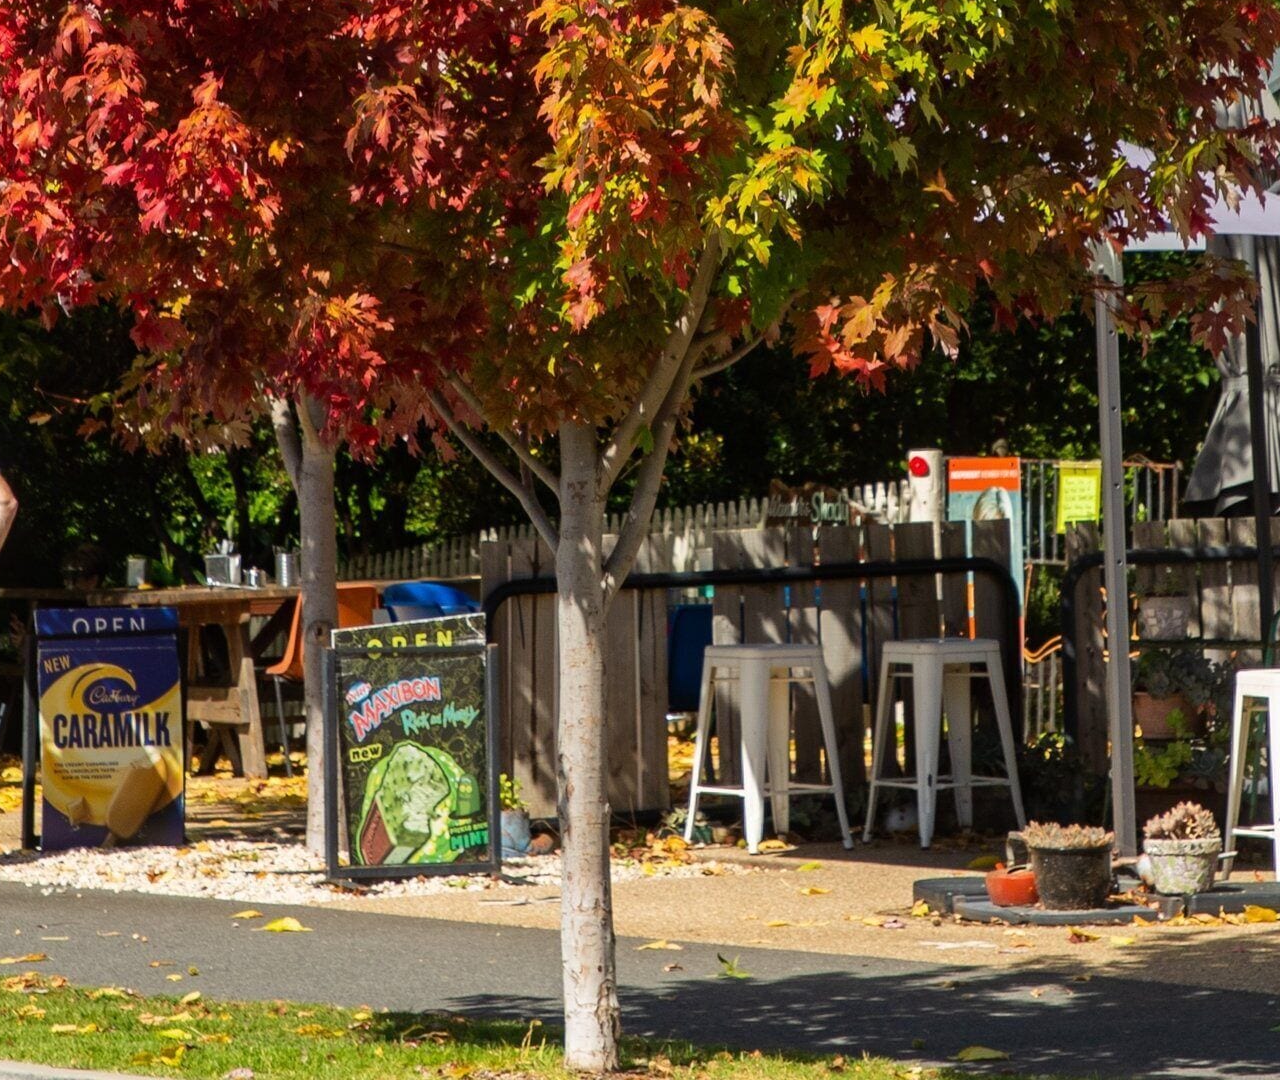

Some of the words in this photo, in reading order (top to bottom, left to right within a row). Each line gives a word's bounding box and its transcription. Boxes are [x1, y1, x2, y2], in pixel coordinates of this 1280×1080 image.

[43, 655, 71, 674] NEW
[89, 684, 141, 708] Cadbury
[350, 677, 441, 742] MAXIBON
[401, 708, 430, 736] Rick
[443, 701, 480, 729] Morty
[53, 712, 171, 749] CARAMILK
[351, 746, 381, 761] new
[451, 831, 489, 850] MINT
